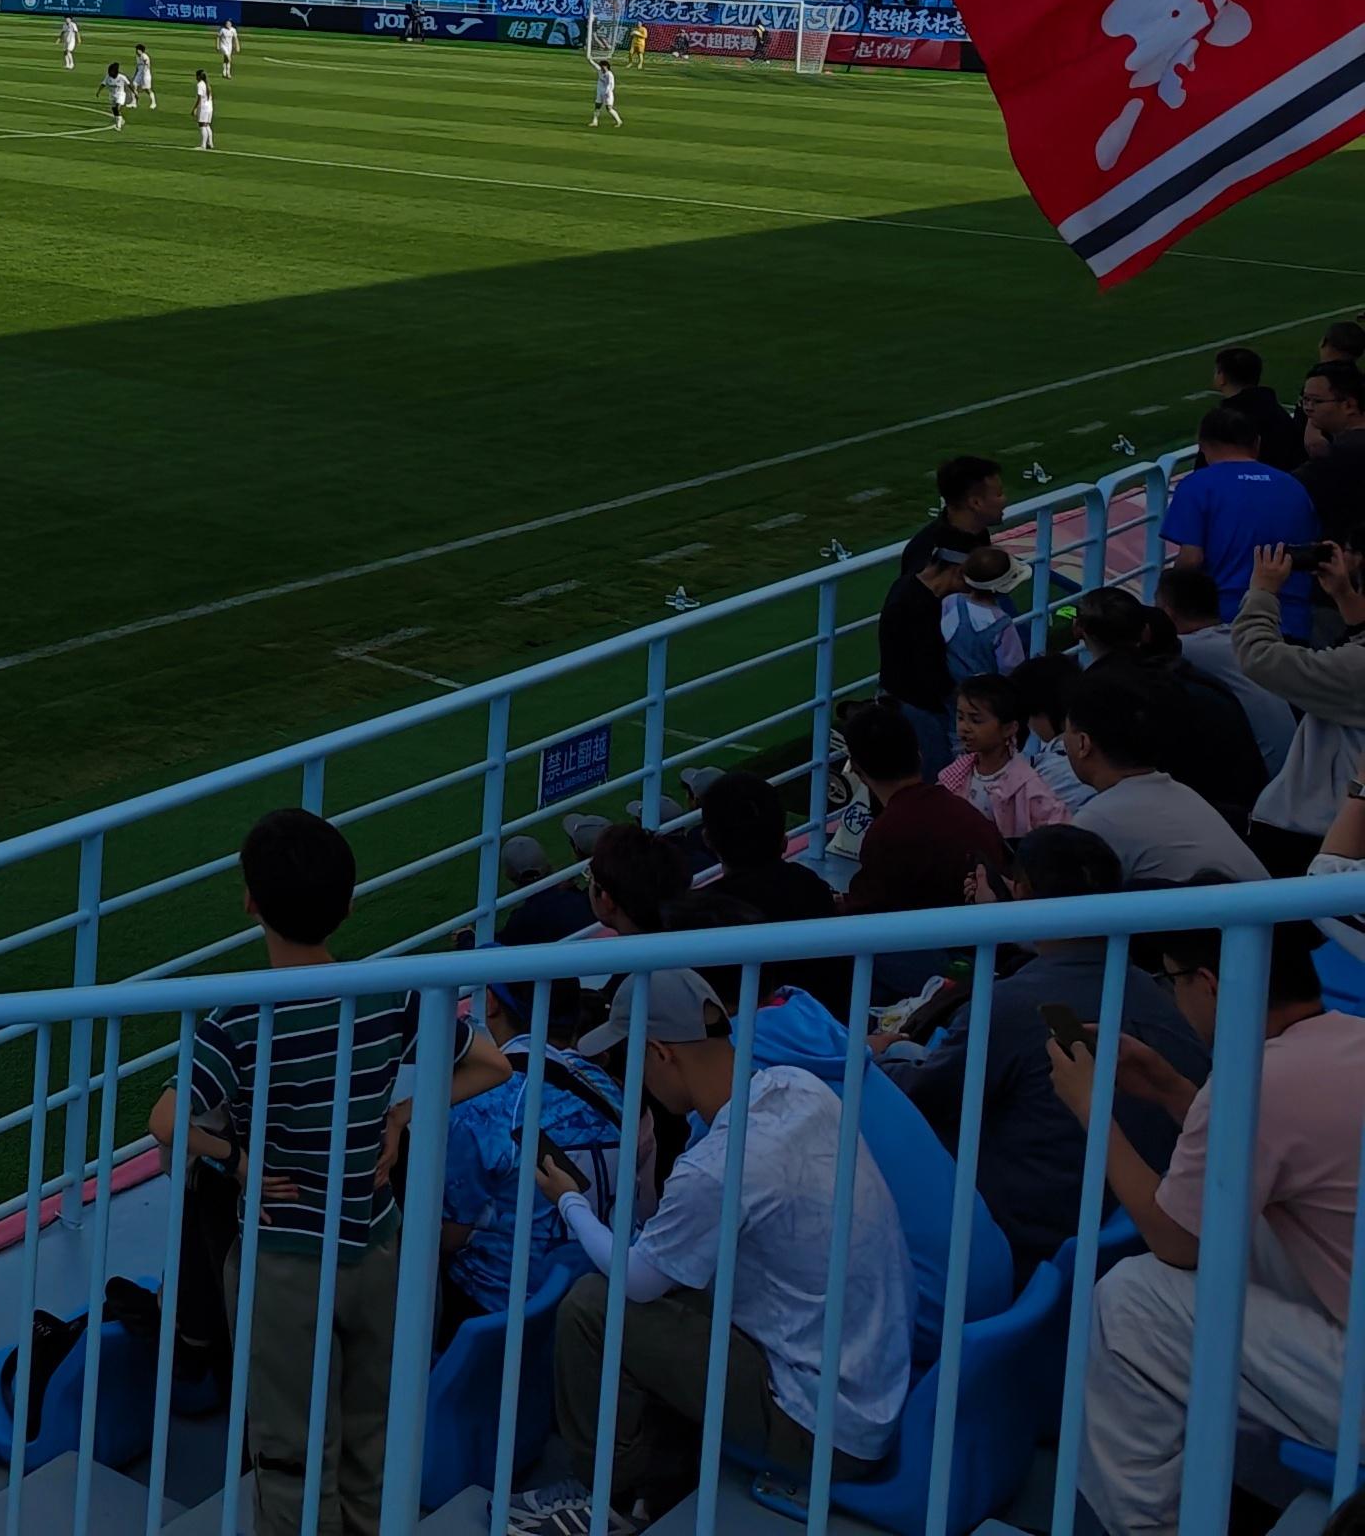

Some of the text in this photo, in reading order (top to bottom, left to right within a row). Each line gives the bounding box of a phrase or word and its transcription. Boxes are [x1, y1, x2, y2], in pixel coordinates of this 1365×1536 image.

[720, 3, 860, 32] CURVA SUD
[868, 6, 968, 35] 铿锵承壮志
[545, 731, 607, 783] 禁止翻越
[544, 764, 607, 797] NO CLIMBING OVER
